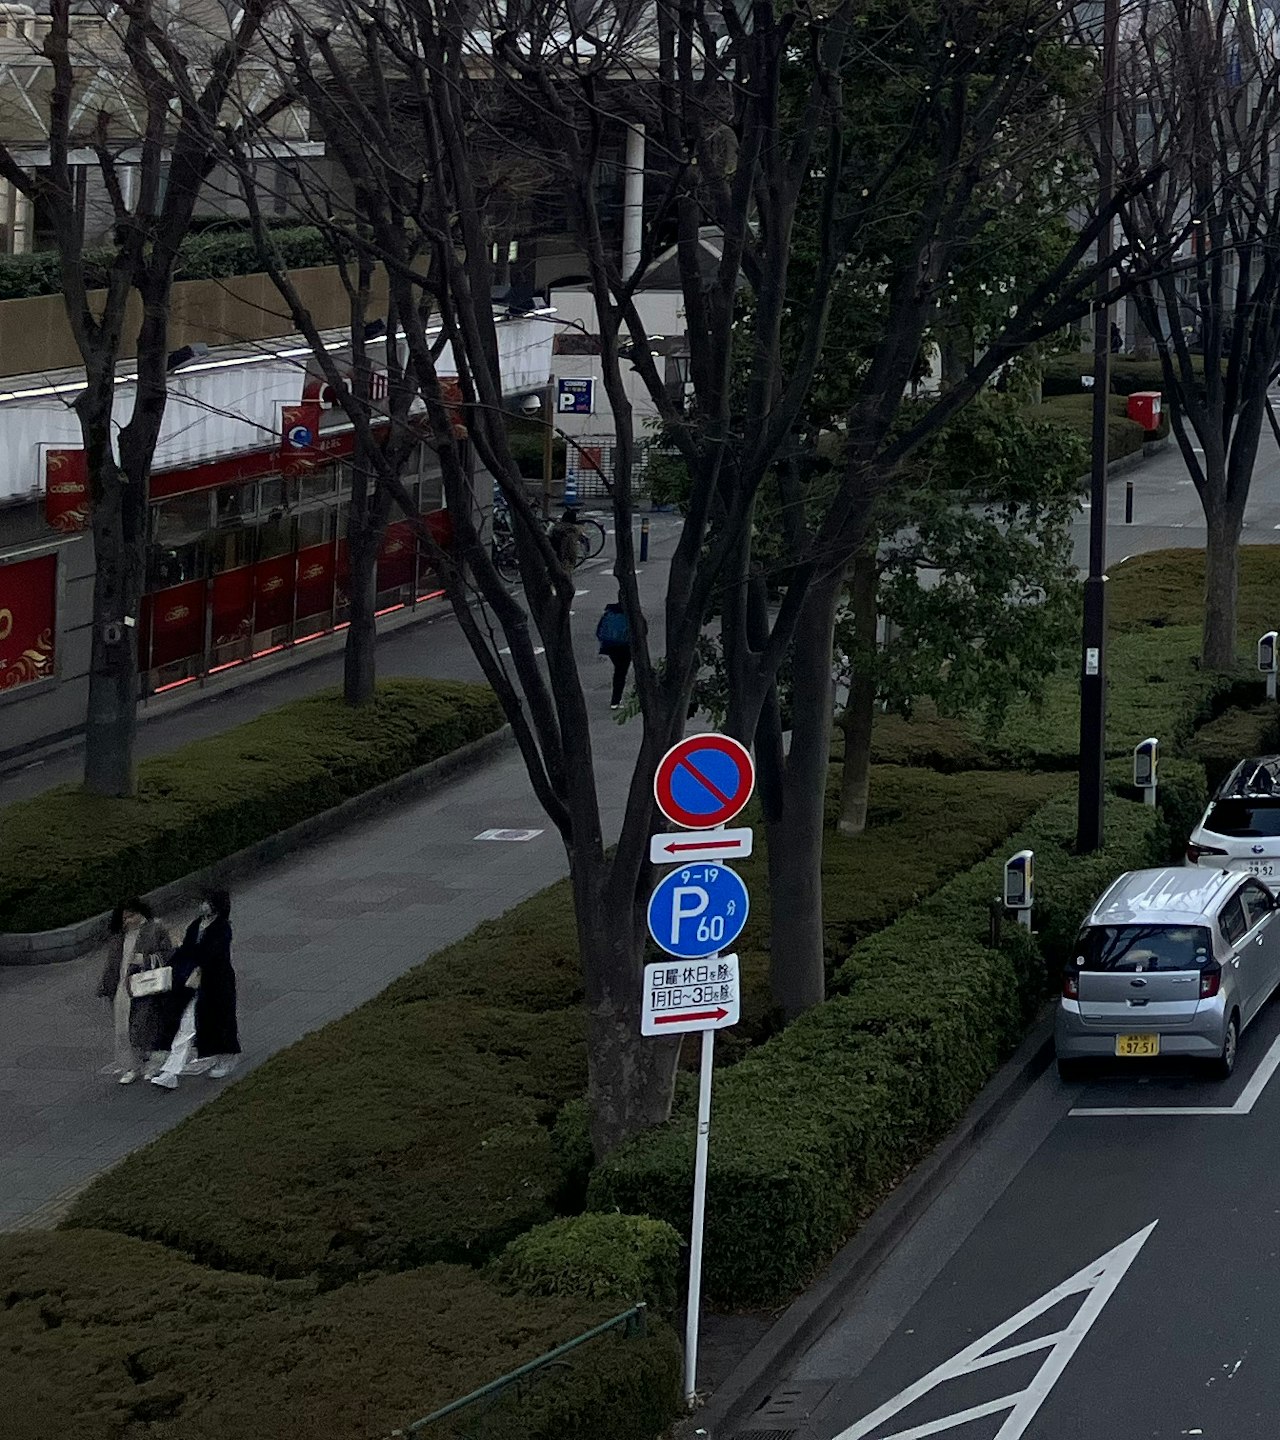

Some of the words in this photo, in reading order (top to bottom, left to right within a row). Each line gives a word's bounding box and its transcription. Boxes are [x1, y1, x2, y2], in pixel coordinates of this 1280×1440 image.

[560, 393, 575, 411] P
[681, 868, 719, 884] 9-19
[670, 886, 709, 944] P
[696, 915, 724, 942] 60
